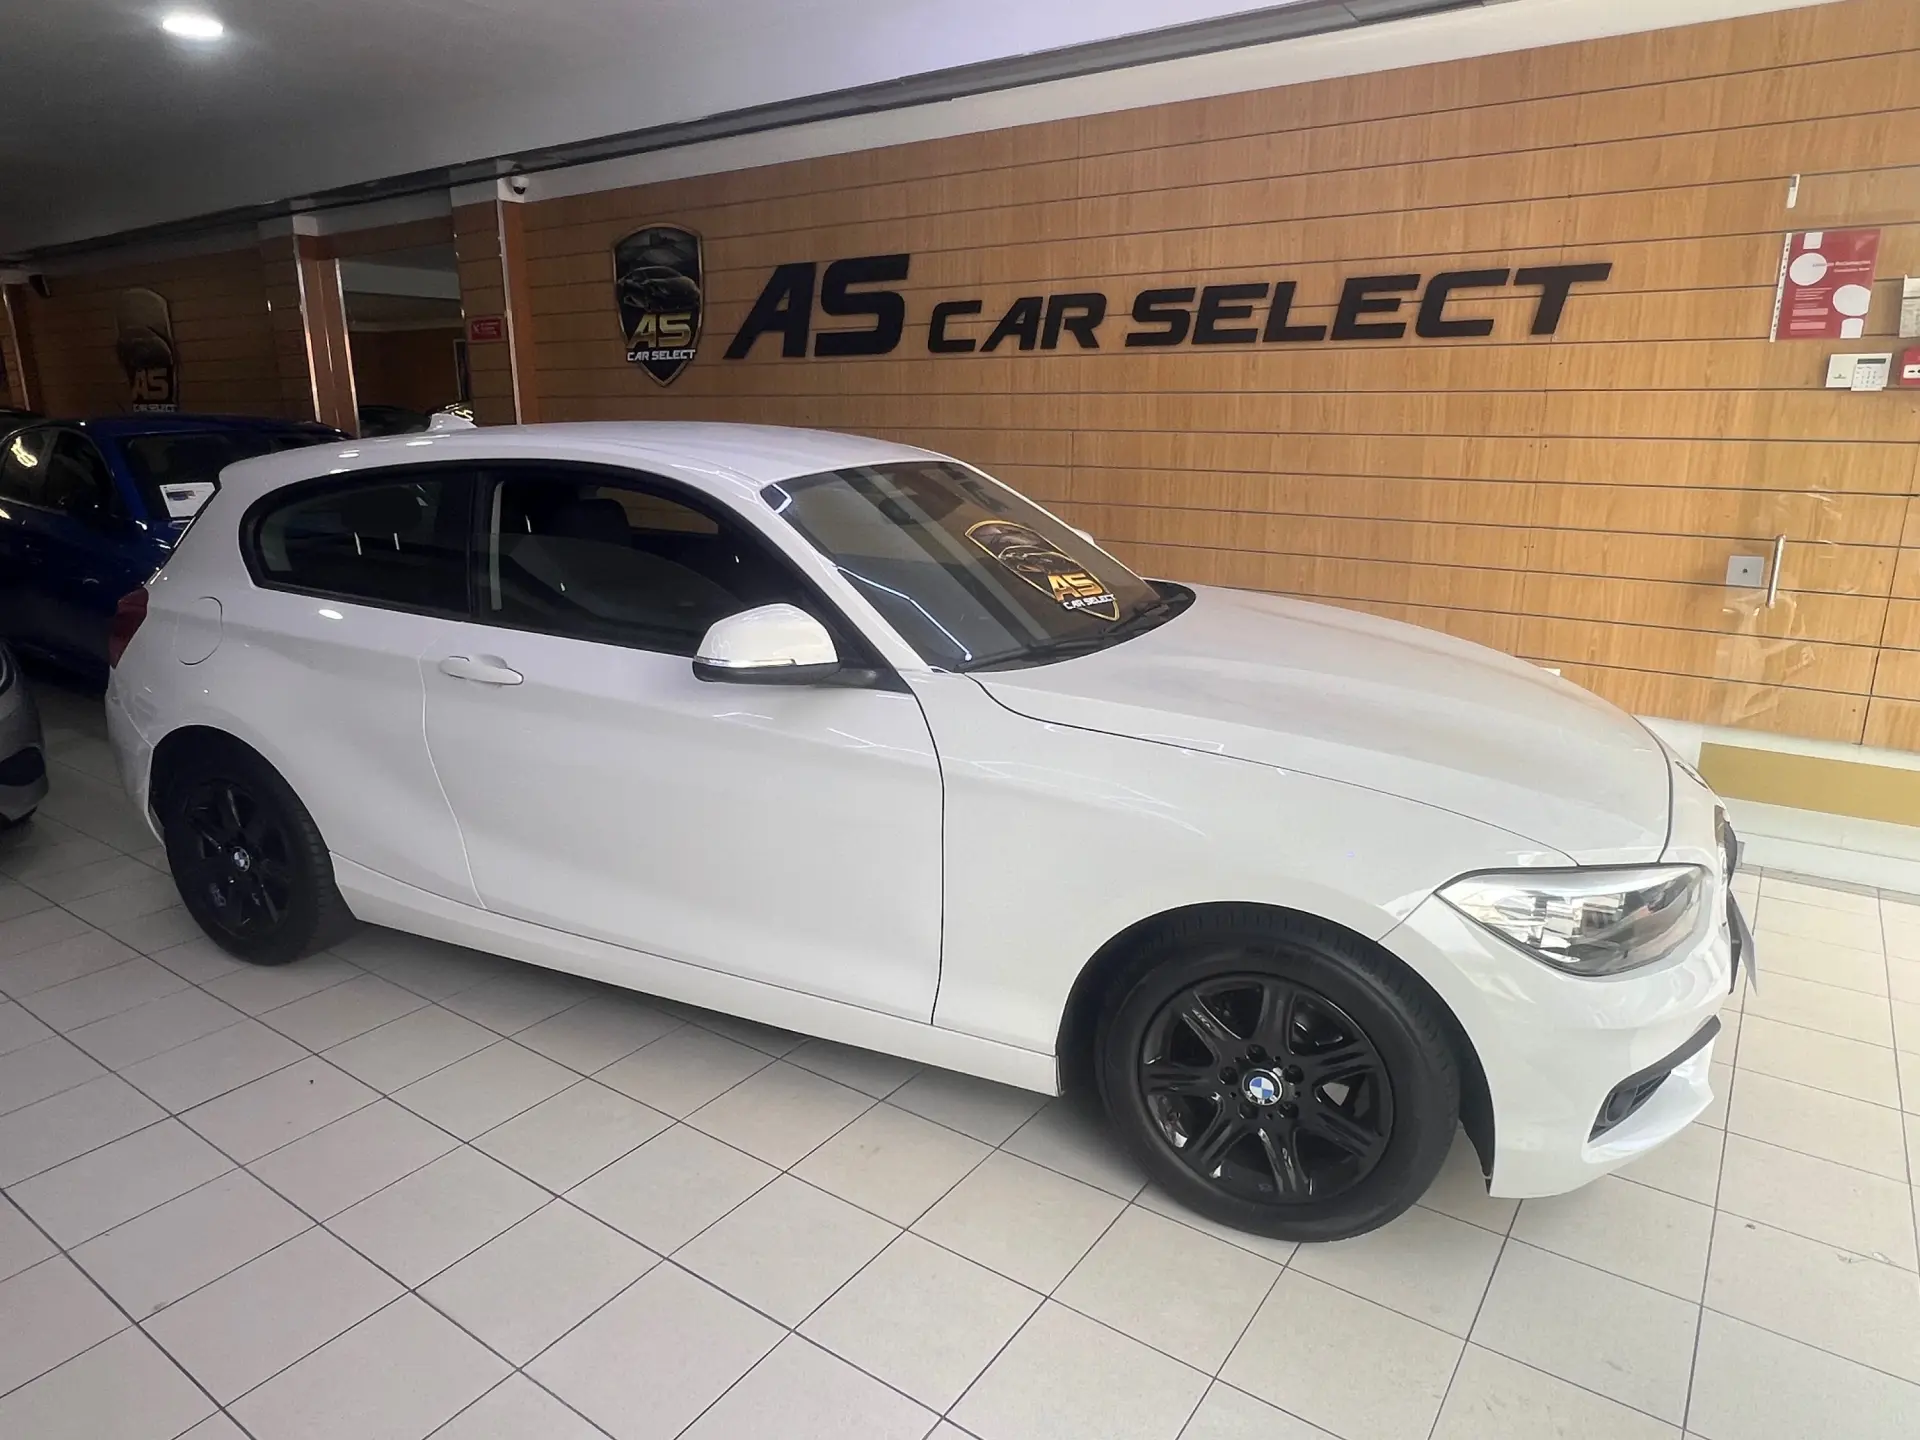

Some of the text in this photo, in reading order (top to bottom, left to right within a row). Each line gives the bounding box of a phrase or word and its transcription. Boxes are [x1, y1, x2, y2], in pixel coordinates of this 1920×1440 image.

[723, 254, 1612, 359] AS CAR SELECT
[627, 313, 691, 348] AS
[627, 349, 696, 361] CAR SELECT
[1048, 573, 1103, 602] AS
[1063, 594, 1115, 610] CAR SELECT
